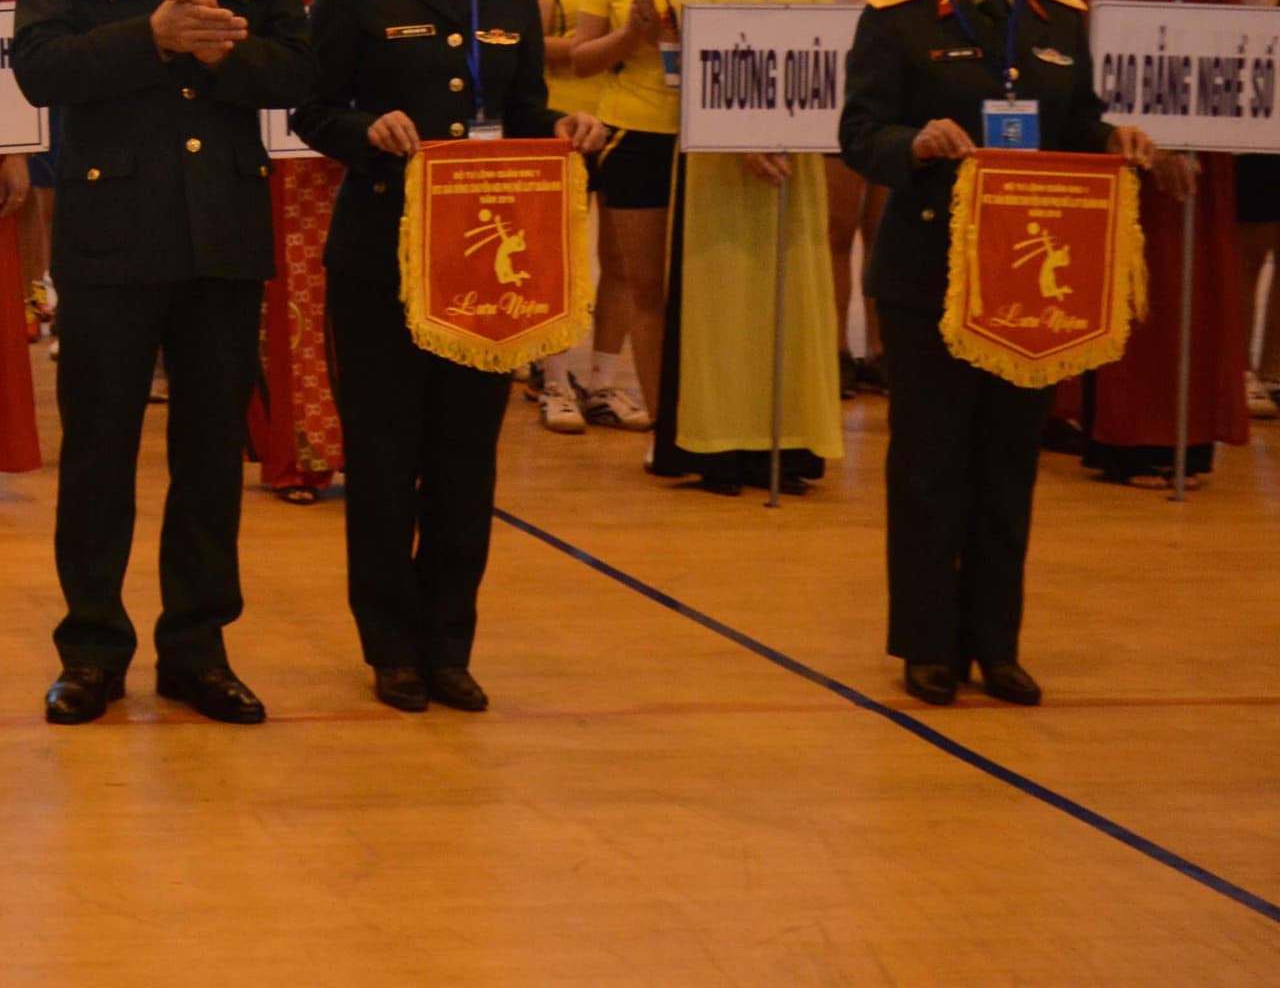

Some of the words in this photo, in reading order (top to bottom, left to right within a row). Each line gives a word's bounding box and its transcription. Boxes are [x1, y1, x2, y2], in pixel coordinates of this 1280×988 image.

[700, 32, 776, 109] TRƯỜNG
[784, 36, 837, 117] QUÂN
[1101, 53, 1137, 114] CAO
[1142, 25, 1192, 115] ĐẲNG
[1197, 34, 1248, 118] NGHỀ
[1251, 36, 1279, 119] SỐ
